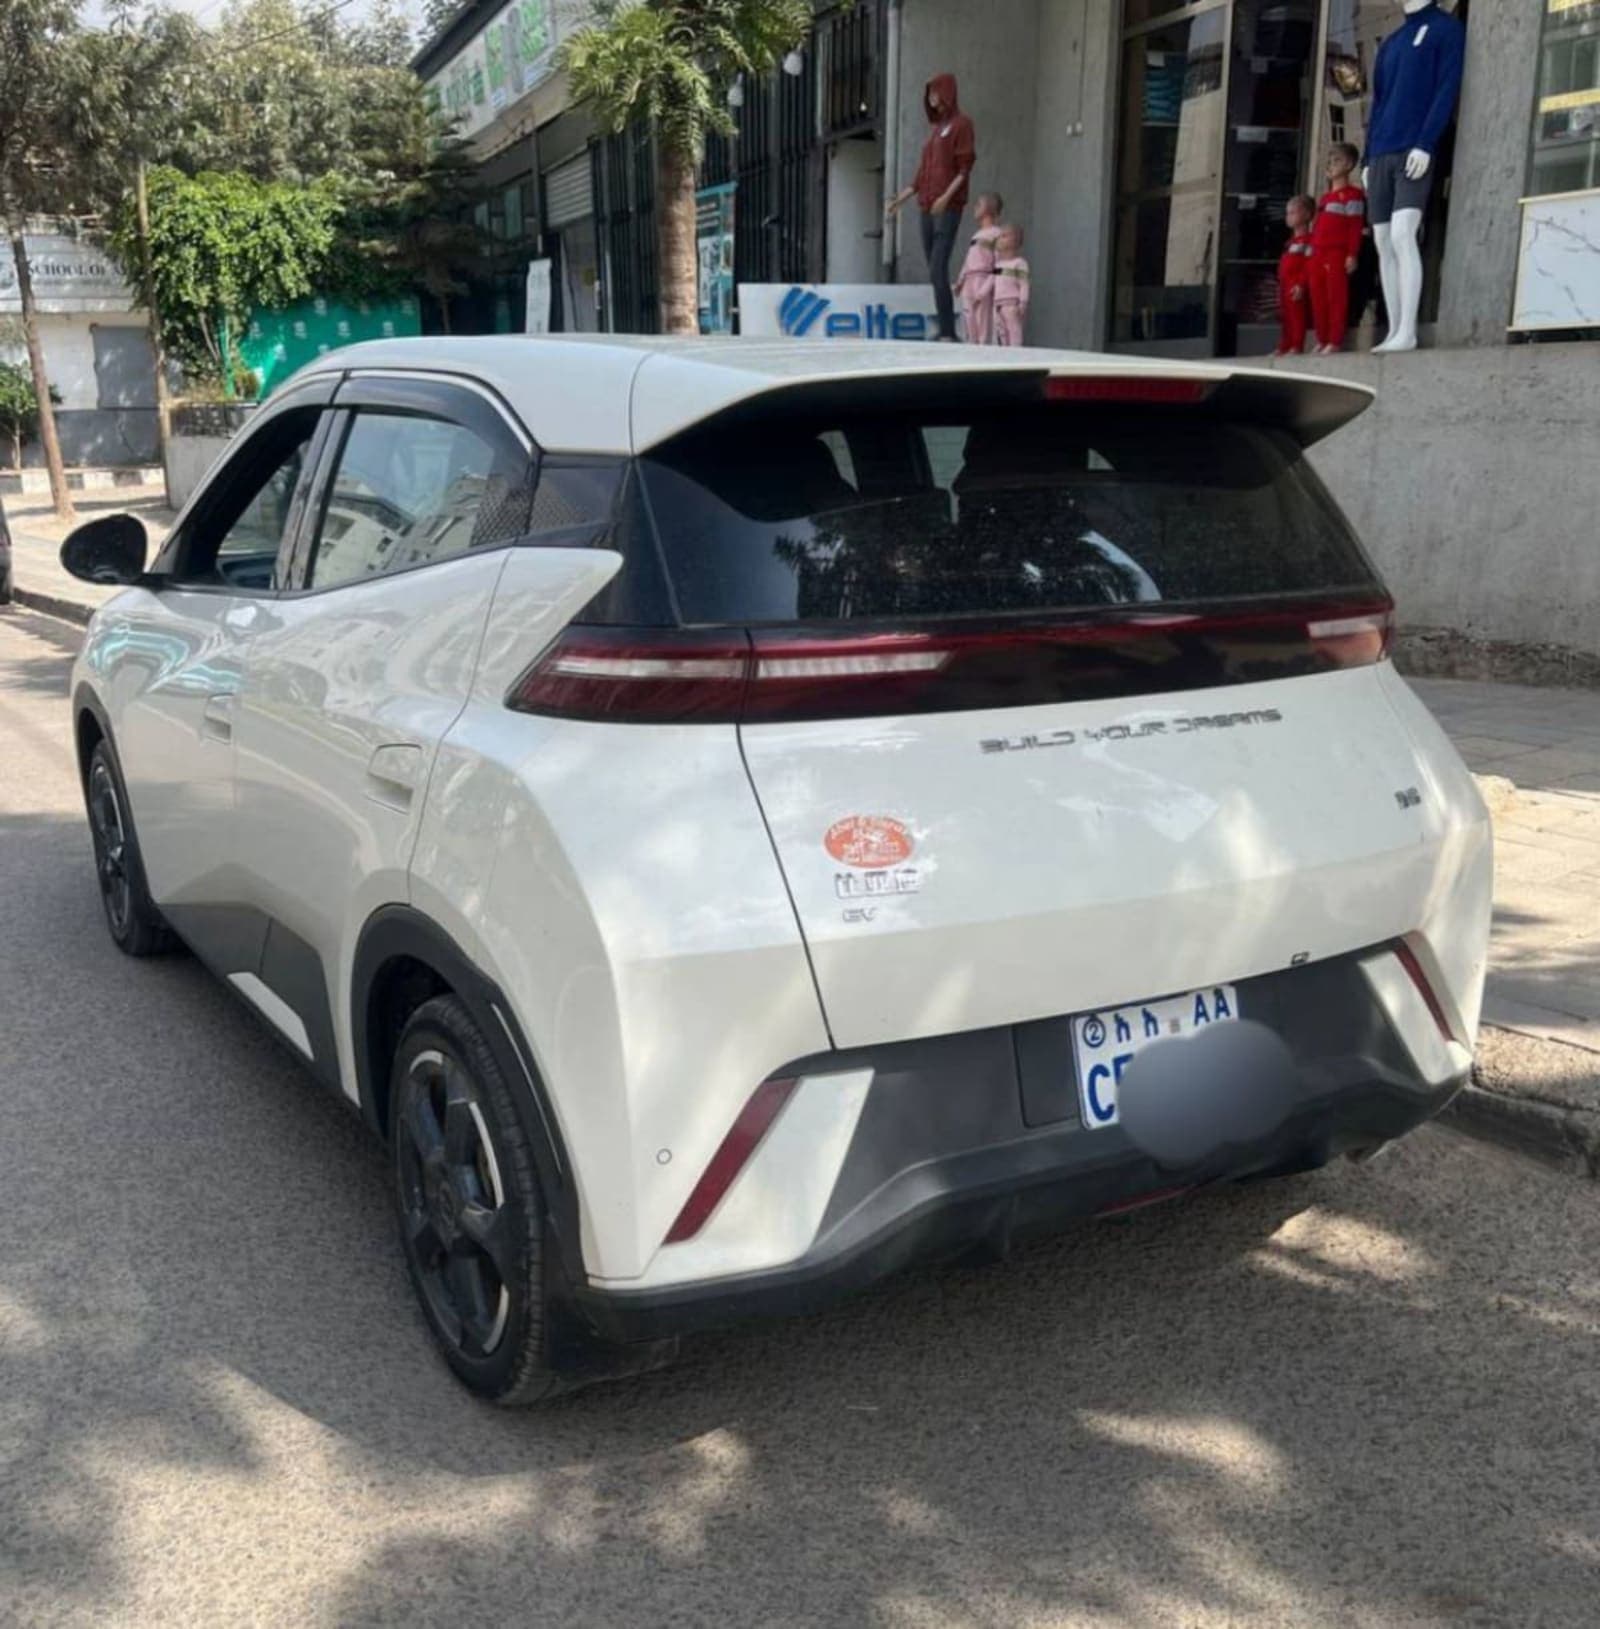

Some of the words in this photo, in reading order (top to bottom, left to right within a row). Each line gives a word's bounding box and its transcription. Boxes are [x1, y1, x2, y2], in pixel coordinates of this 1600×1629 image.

[979, 730, 1075, 754] BUILD
[1084, 720, 1169, 742] YOUR
[1172, 708, 1284, 734] DREAMS
[1194, 986, 1231, 1026] AA
